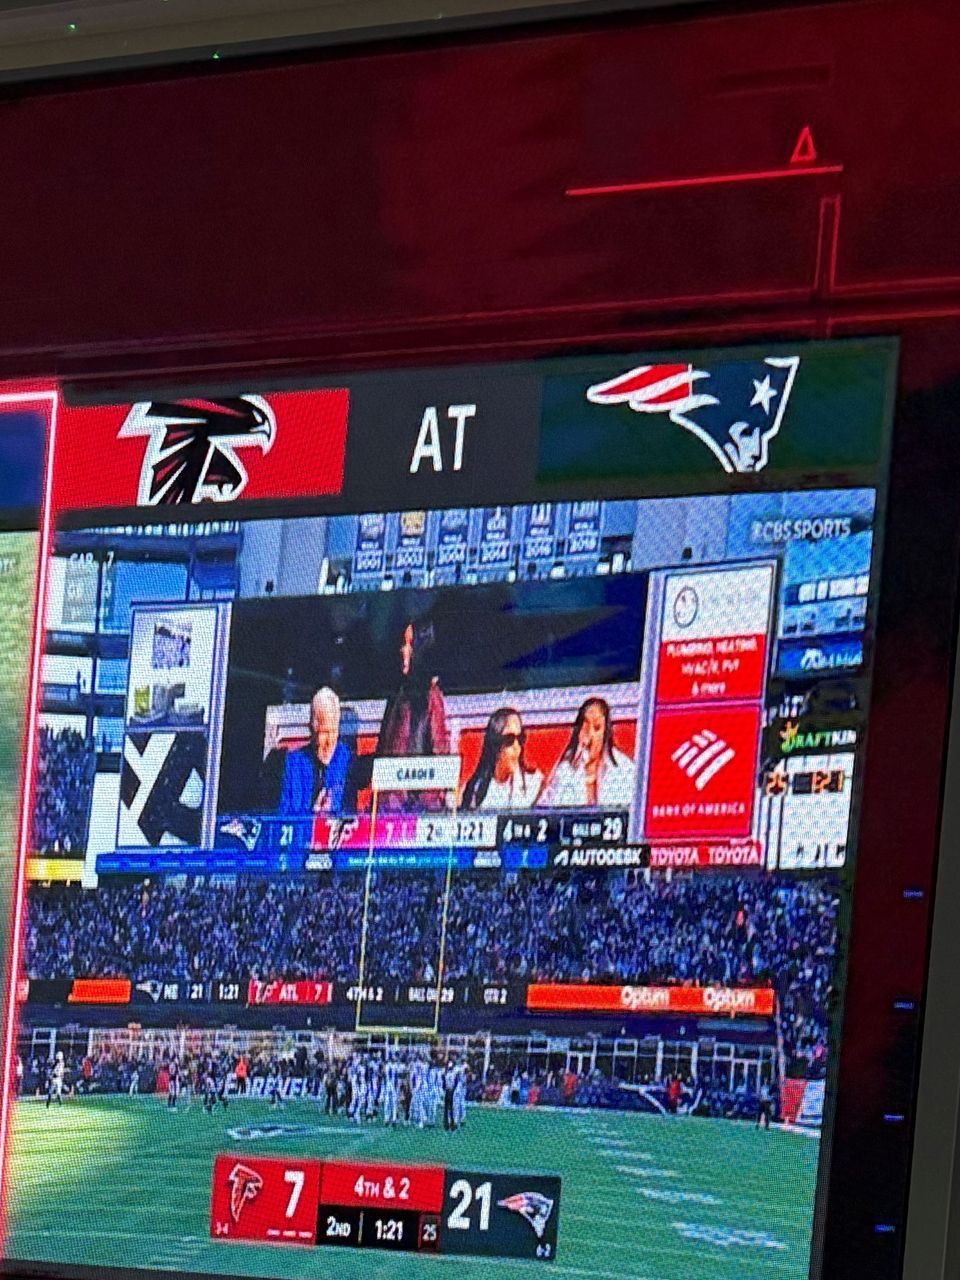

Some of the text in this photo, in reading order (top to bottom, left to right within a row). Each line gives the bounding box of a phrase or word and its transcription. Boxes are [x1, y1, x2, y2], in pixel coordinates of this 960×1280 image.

[409, 403, 476, 474] AT
[793, 517, 852, 540] SPORTS
[651, 846, 760, 866] TOYOTA TOYOTA
[621, 985, 755, 1012] Optum Optum
[284, 1170, 304, 1218] 7
[354, 1175, 411, 1199] 4TH & 2
[447, 1179, 492, 1230] 21
[326, 1216, 351, 1237] 2ND
[375, 1219, 403, 1241] 1:21
